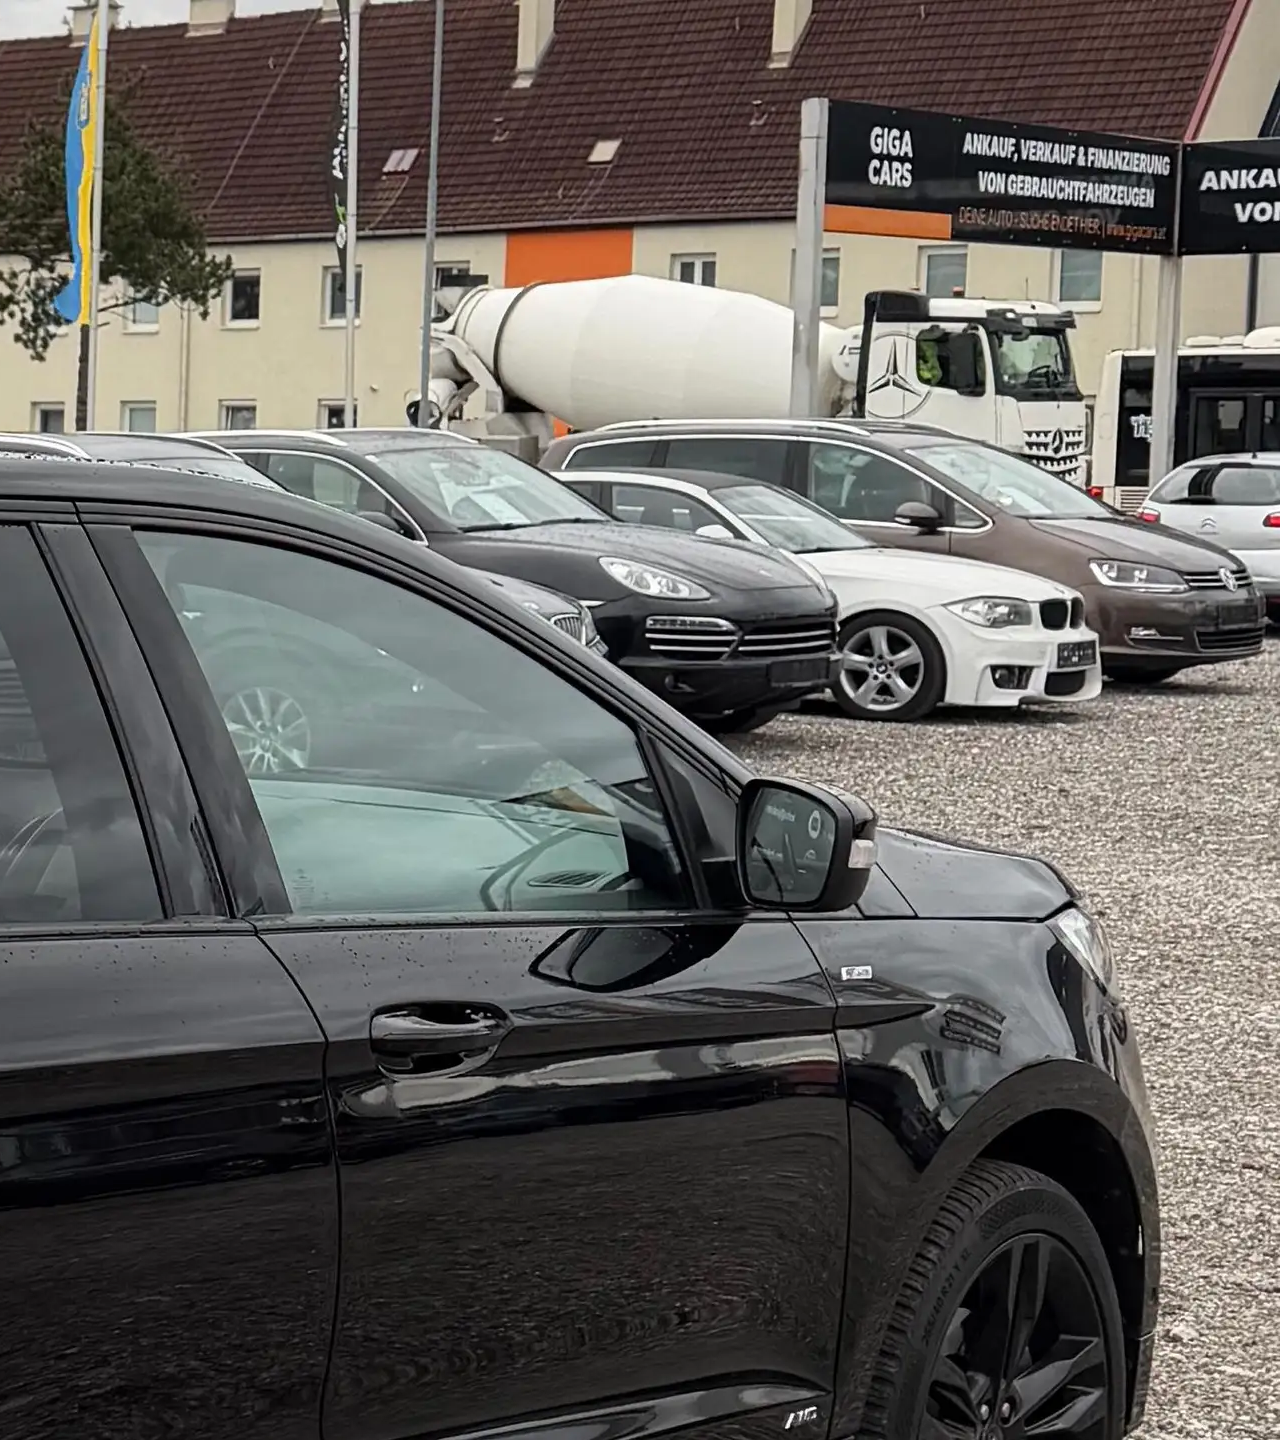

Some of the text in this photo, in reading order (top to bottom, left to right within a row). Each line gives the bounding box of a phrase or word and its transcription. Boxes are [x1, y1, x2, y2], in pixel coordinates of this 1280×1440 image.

[870, 126, 913, 158] GIGA
[962, 132, 1018, 163] ANKAUF,
[1020, 138, 1076, 166] VERKAUF
[1088, 147, 1171, 176] FINANZIERUNG
[868, 159, 913, 188] CARS
[978, 170, 1156, 208] VON GEBRAUCHTFAHRZEUGEN
[1199, 168, 1280, 191] ANKA
